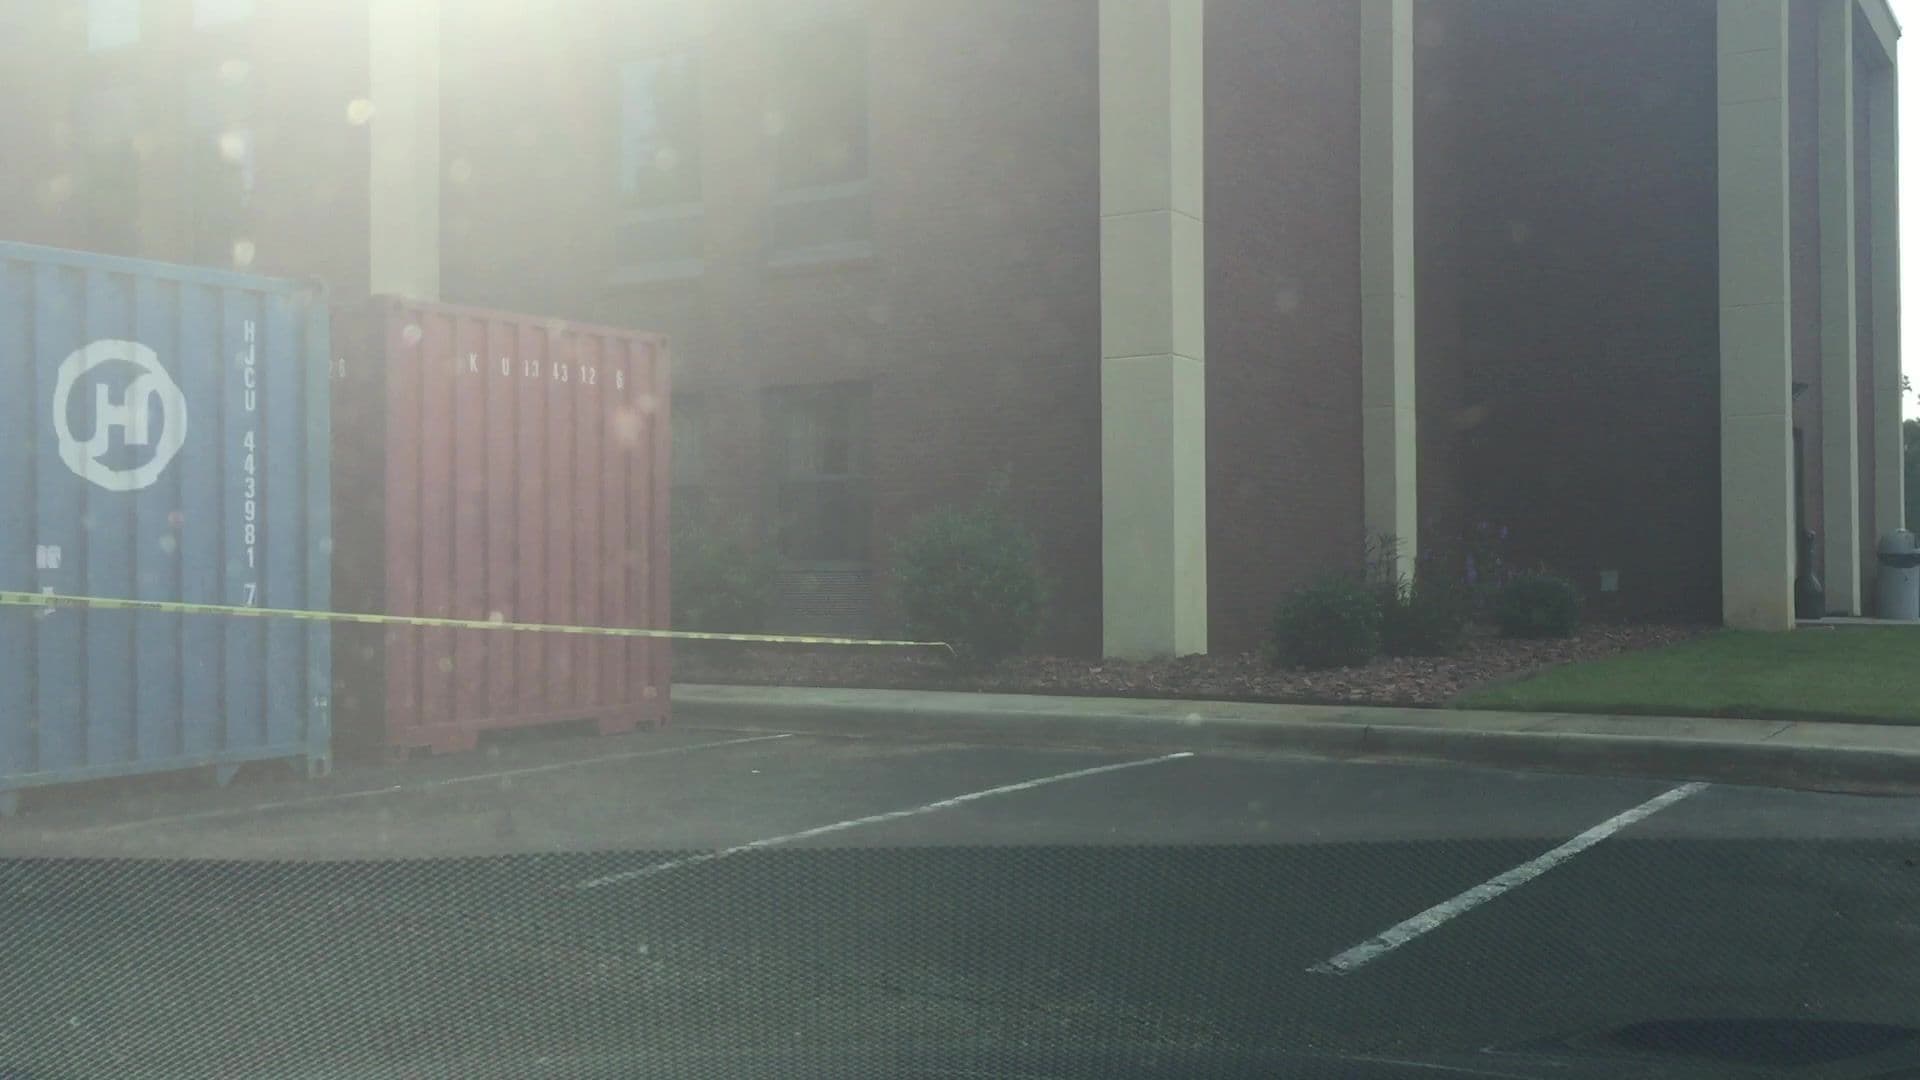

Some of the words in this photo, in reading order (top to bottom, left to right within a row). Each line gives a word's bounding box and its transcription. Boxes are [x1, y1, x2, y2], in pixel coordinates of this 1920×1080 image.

[243, 319, 256, 411] HJCU
[243, 430, 256, 569] 443981
[243, 583, 257, 608] 7
